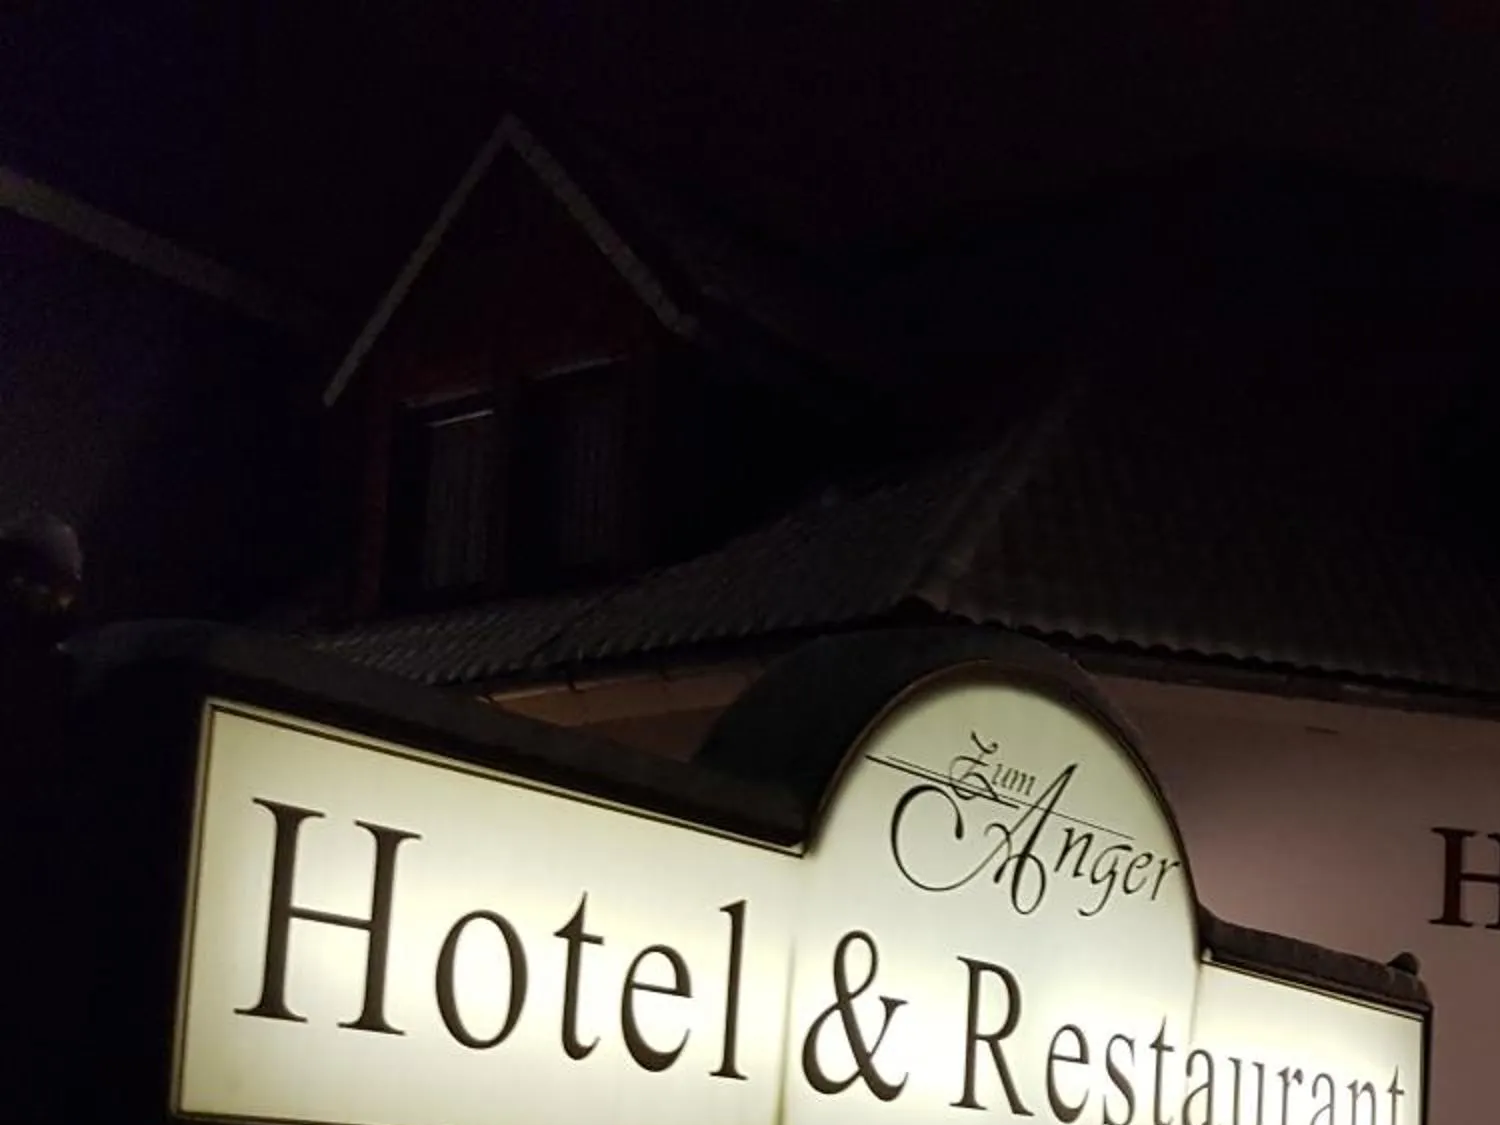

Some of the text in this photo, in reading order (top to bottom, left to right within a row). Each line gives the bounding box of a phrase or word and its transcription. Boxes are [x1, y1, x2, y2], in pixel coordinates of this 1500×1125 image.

[890, 763, 1181, 917] Anger
[948, 731, 1037, 801] Zum
[234, 797, 749, 1081] Hotel
[801, 931, 909, 1101] &
